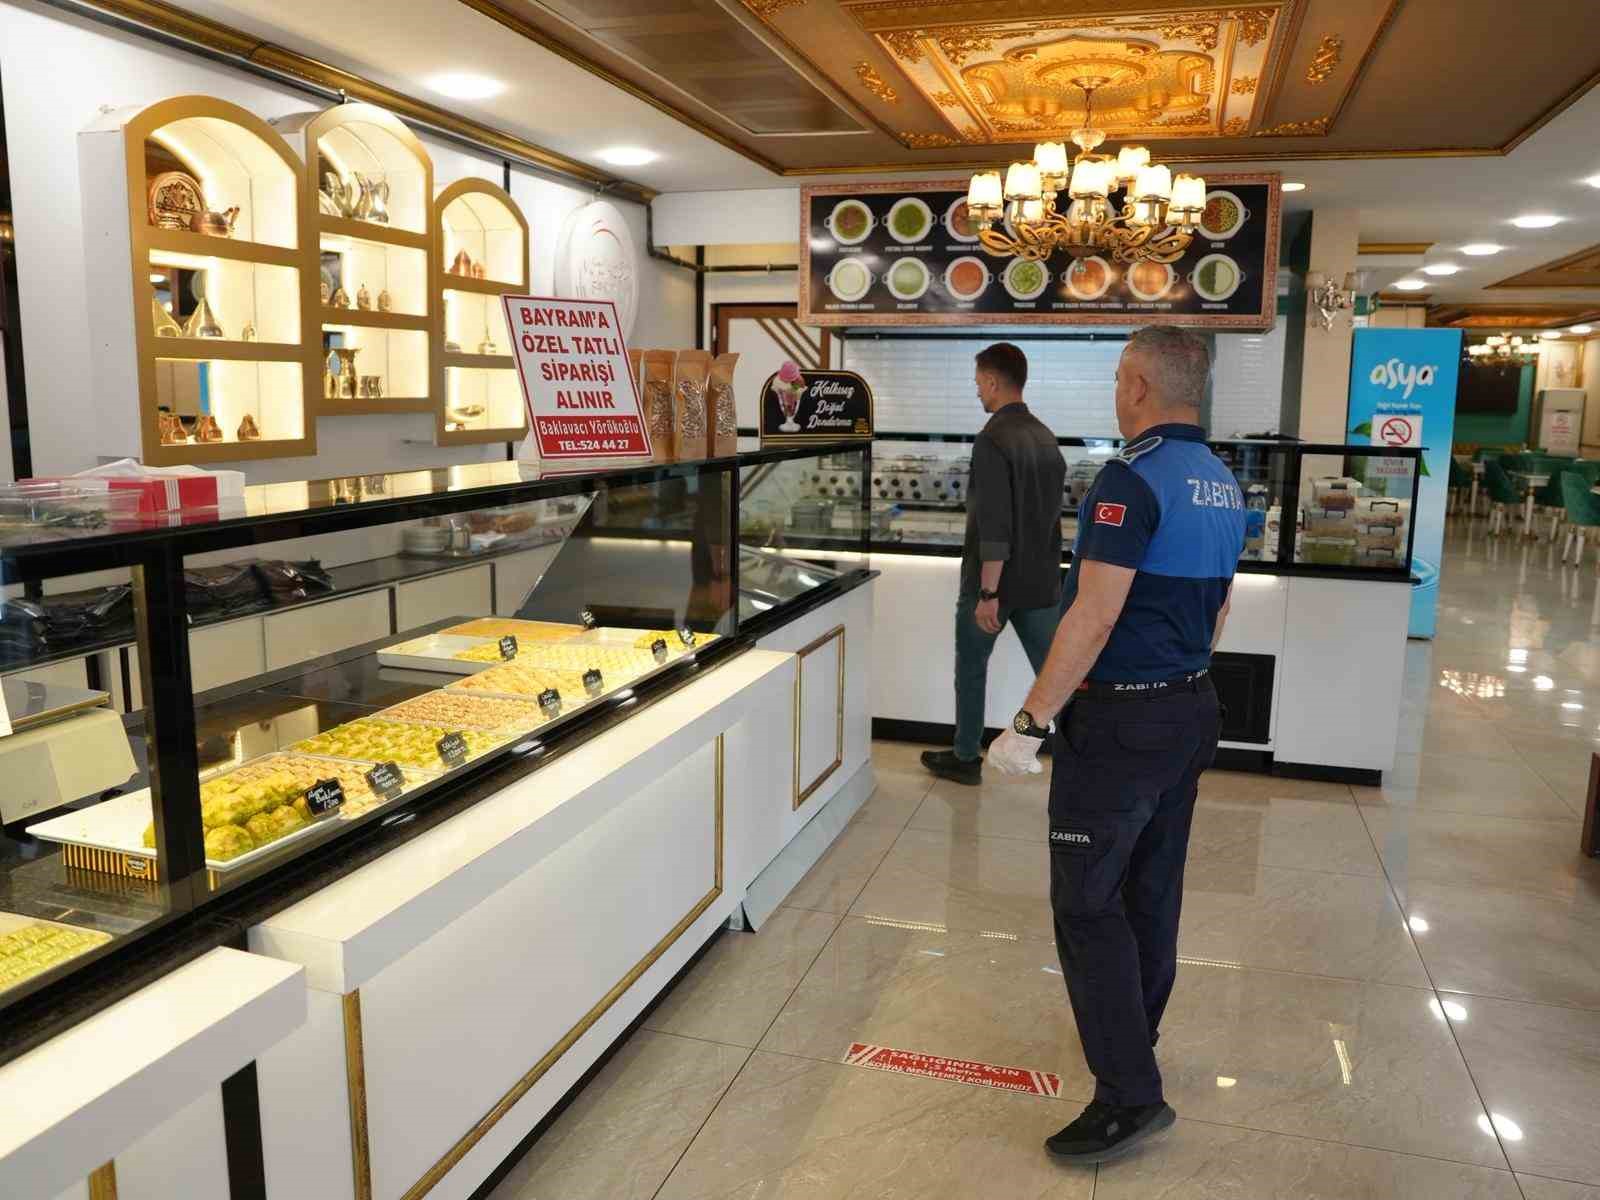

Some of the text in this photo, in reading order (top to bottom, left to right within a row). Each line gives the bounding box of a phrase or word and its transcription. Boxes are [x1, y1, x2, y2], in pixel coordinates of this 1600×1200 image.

[520, 307, 610, 329] BAYRAM'A
[522, 331, 620, 355] ÖZEL TATLI
[541, 359, 615, 386] SİPARİŞİ
[1370, 358, 1434, 399] asya
[557, 390, 615, 409] ALINIR
[540, 420, 587, 436] Baklavacı
[558, 440, 629, 451] TEL:524 44 27
[1113, 681, 1168, 691] ZABITA
[1050, 831, 1091, 843] ZABITA
